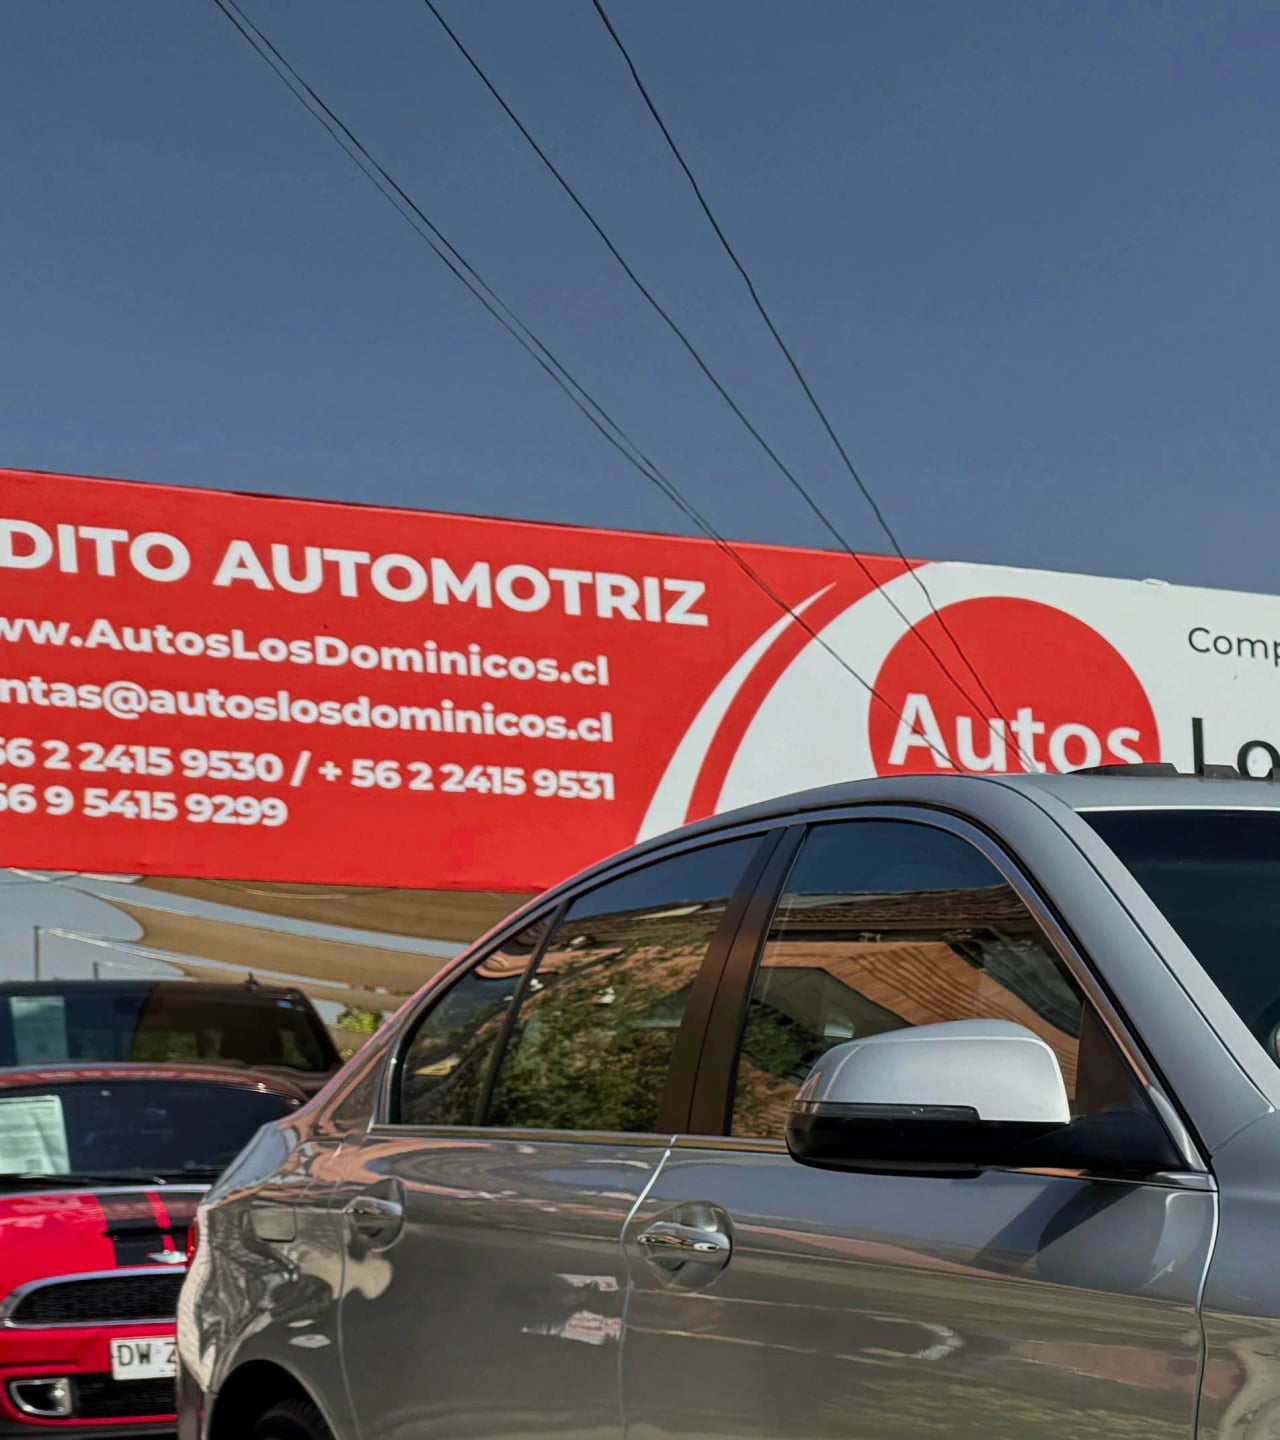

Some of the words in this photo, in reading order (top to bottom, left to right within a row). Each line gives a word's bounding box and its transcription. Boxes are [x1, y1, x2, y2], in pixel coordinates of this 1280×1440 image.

[0, 519, 190, 582] DITO
[213, 540, 708, 626] AUTOMOTRIZ
[888, 693, 1142, 773] Autos
[0, 738, 35, 767] 6
[43, 740, 71, 769] 2
[78, 743, 173, 776] 2415
[181, 749, 283, 782] 9530
[352, 759, 401, 788] 56
[408, 762, 433, 790] 2
[440, 764, 526, 795] 2415
[533, 769, 614, 800] 9531
[0, 783, 36, 813] 6
[45, 786, 74, 815] 9
[84, 788, 177, 820] 5415
[185, 794, 287, 826] 9299
[117, 1343, 151, 1366] DW
